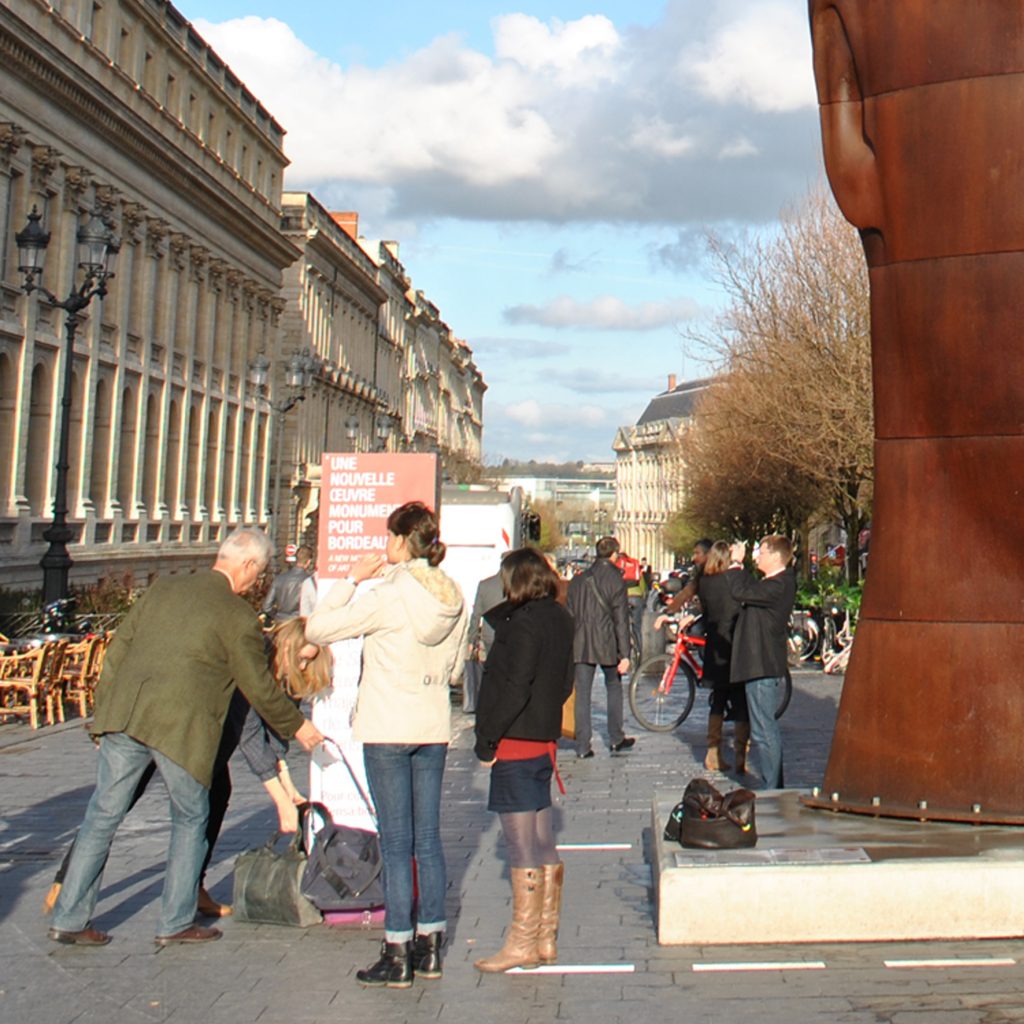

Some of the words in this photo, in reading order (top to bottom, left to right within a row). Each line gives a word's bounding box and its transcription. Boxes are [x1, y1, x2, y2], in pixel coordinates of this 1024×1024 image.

[331, 457, 357, 470] UNE
[330, 472, 395, 486] NOUVELLE
[330, 488, 376, 502] ŒUVRE
[329, 504, 401, 518] MONUMEN
[328, 520, 363, 534] POUR
[328, 536, 388, 550] BORDEAU
